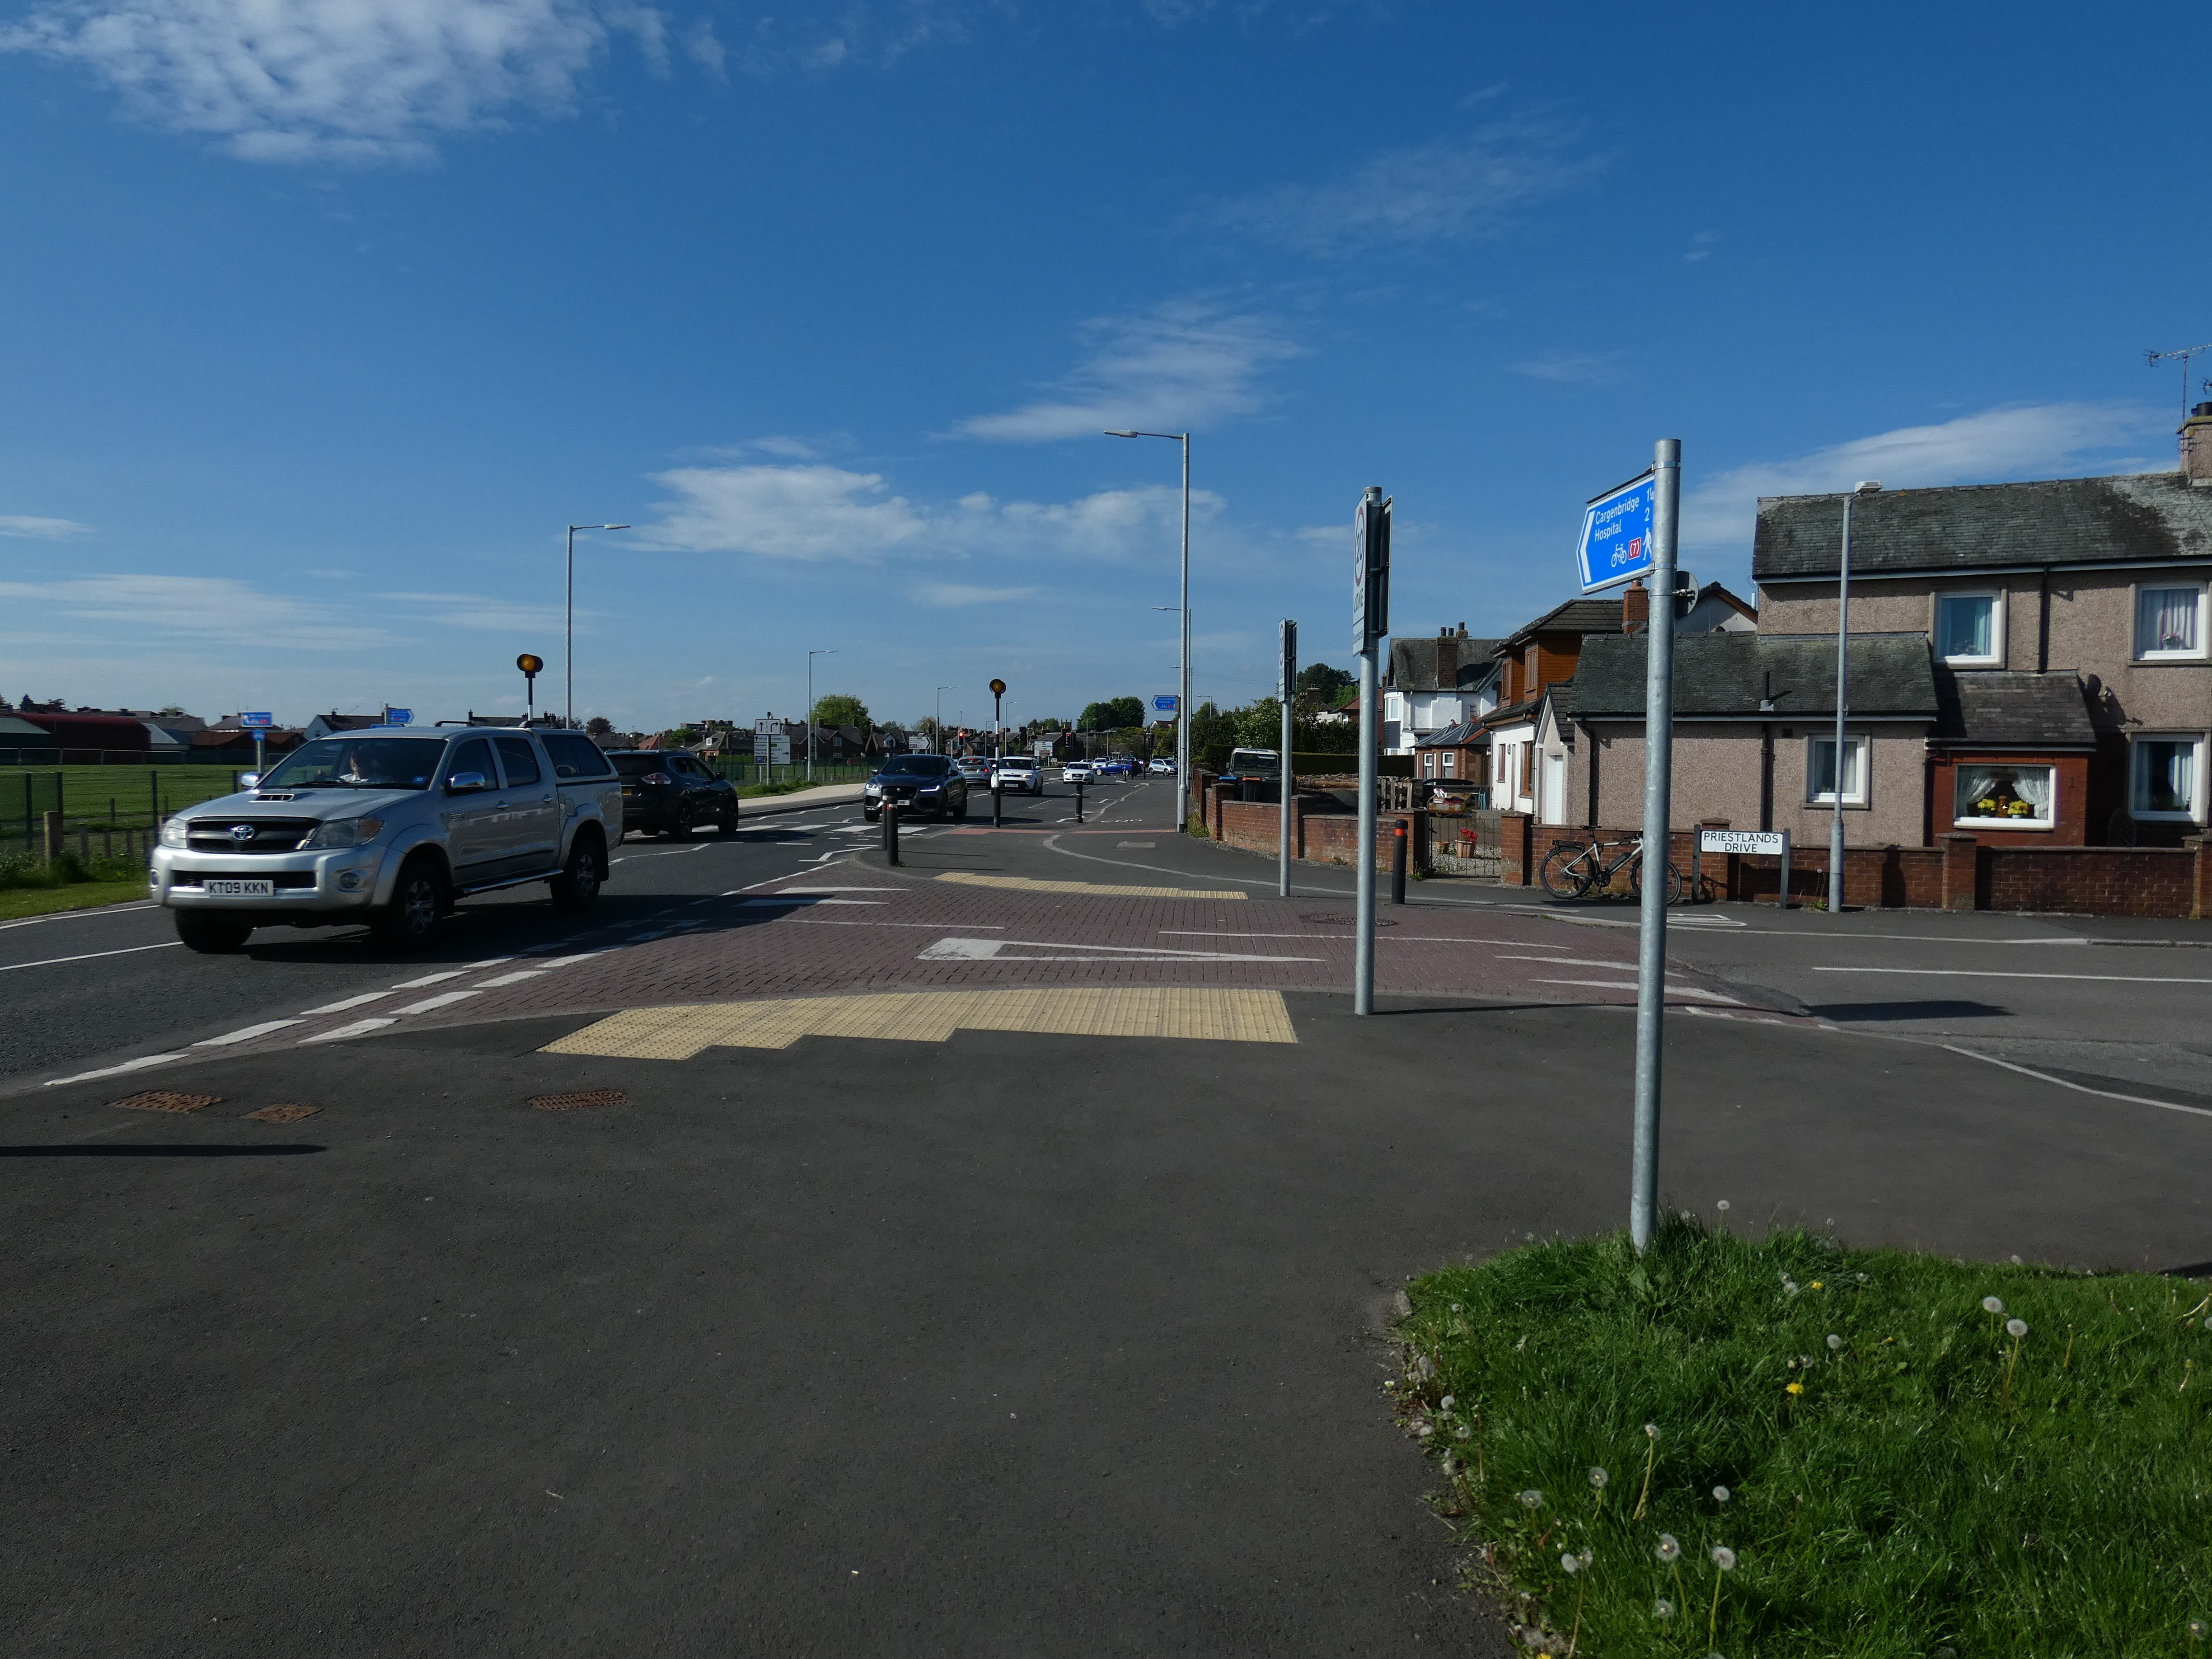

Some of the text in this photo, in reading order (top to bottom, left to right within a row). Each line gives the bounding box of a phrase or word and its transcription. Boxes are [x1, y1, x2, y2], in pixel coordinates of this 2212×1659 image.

[1595, 497, 1639, 525] Cargenbridge
[1594, 507, 1650, 542] Hospital 2
[1356, 528, 1363, 564] 20
[1354, 588, 1364, 613] ZONE
[1704, 832, 1778, 843] PRIESTLANDS
[1725, 843, 1757, 853] DRIVE
[209, 882, 269, 894] KT09 KKN
